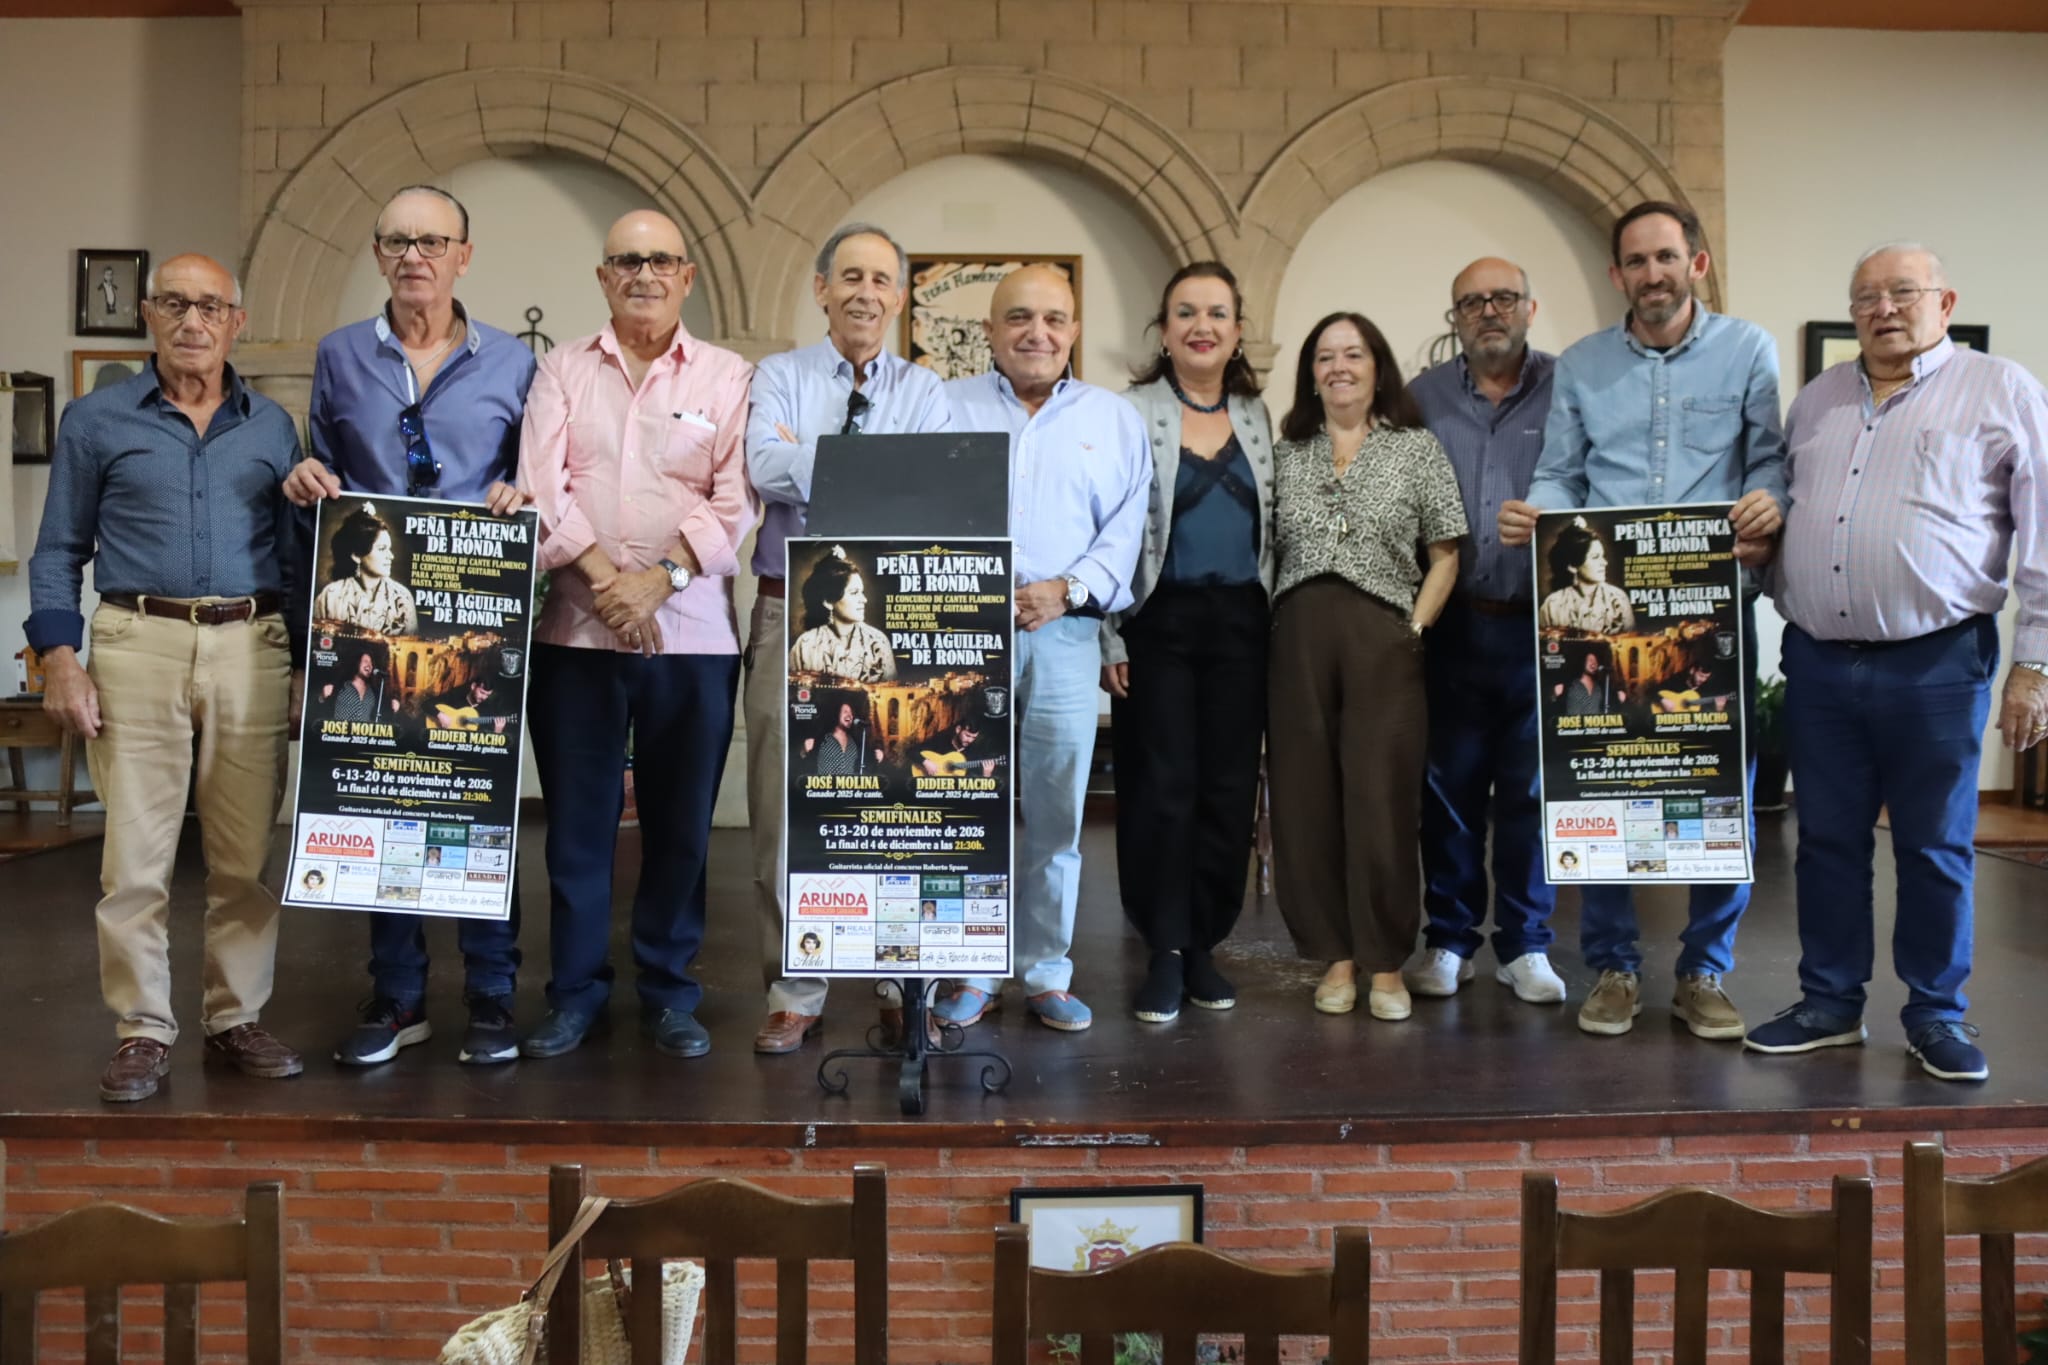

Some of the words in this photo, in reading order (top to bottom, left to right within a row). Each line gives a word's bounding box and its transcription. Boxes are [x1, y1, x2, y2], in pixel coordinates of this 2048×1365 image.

[922, 281, 951, 302] Peña
[953, 271, 1008, 288] Flamenc
[405, 514, 447, 537] PEÑA
[450, 520, 529, 544] FLAMENCA
[1615, 521, 1654, 540] PEÑA
[1658, 519, 1732, 538] FLAMENCA
[426, 535, 448, 554] DE
[451, 537, 504, 558] RONDA
[1637, 539, 1656, 554] DE
[1660, 536, 1710, 553] RONDA
[421, 554, 457, 564] CONCURSO
[458, 557, 468, 565] DE
[469, 558, 491, 567] CANTE
[492, 560, 527, 570] FLAMENCO
[877, 554, 918, 575] PEÑA
[924, 556, 1004, 575] FLAMENCA
[411, 571, 429, 579] PARA
[419, 563, 455, 573] CERTAMEN
[467, 567, 501, 577] GUITARRA
[411, 579, 432, 587] HASTA
[444, 580, 462, 590] AÑOS
[900, 575, 921, 592] DE
[926, 575, 980, 592] RONDA
[415, 590, 452, 607] PACA
[455, 594, 522, 614] AGUILERA
[945, 595, 967, 603] CANTE
[969, 595, 1005, 603] FLAMENCO
[1630, 589, 1664, 604] PACA
[1668, 585, 1731, 602] AGUILERA
[1649, 603, 1666, 617] DE
[1670, 600, 1714, 616] RONDA
[433, 607, 453, 623] DE
[456, 609, 504, 627] RONDA
[921, 621, 938, 629] AÑOS
[892, 633, 929, 648] PACA
[933, 634, 1003, 649] AGUILERA
[912, 650, 931, 665] DE
[936, 650, 984, 665] RONDA
[1557, 715, 1581, 728] JOSÉ
[1584, 714, 1623, 727] MOLINA
[1656, 713, 1691, 725] DIDIER
[1694, 712, 1728, 724] MACHO
[321, 719, 348, 734] JOSÉ
[350, 722, 394, 737] MOLINA
[321, 734, 351, 743] Ganador
[351, 736, 368, 744] 2025
[429, 729, 467, 743] DIDIER
[470, 733, 506, 746] MACHO
[428, 742, 456, 750] Ganador
[1606, 742, 1680, 756] SEMIFINALES
[372, 757, 453, 774] SEMIFINALES
[1571, 757, 1614, 769] 6-13-20
[1616, 757, 1628, 767] de
[1630, 755, 1680, 767] noviembre
[1682, 755, 1694, 765] de
[1696, 754, 1719, 765] 2026
[332, 768, 380, 782] 6-13-20
[382, 772, 395, 783] de
[397, 773, 452, 787] noviembre
[453, 777, 466, 788] de
[467, 778, 493, 790] 2026
[1576, 771, 1587, 780] La
[1588, 770, 1606, 779] final
[1607, 770, 1615, 778] el
[1616, 770, 1622, 778] 4
[1623, 770, 1632, 778] de
[1634, 768, 1671, 778] diciembre
[1679, 768, 1691, 776] las
[805, 775, 832, 789] JOSÉ
[836, 776, 879, 789] MOLINA
[917, 778, 955, 790] DIDIER
[958, 778, 995, 790] MACHO
[337, 782, 348, 792] La
[349, 783, 370, 793] final
[371, 785, 379, 794] el
[380, 785, 386, 795] 4
[388, 786, 398, 795] de
[399, 786, 440, 798] diciembre
[449, 790, 461, 800] las
[462, 791, 492, 802] 21:30h.
[860, 810, 942, 823] SEMIFINALES
[1555, 816, 1617, 829] ARUNDA
[819, 824, 868, 836] 6-13-20
[871, 825, 884, 836] de
[886, 825, 942, 837] noviembre
[944, 826, 957, 837] de
[959, 826, 985, 837] 2026
[306, 831, 375, 848] ARUNDA
[825, 840, 836, 849] La
[838, 839, 858, 849] final
[860, 840, 868, 849] el
[870, 840, 876, 849] 4
[878, 840, 888, 849] de
[889, 840, 931, 849] diciembre
[940, 840, 953, 849] las
[955, 840, 984, 850] 21:30h.
[799, 892, 868, 906] ARUNDA
